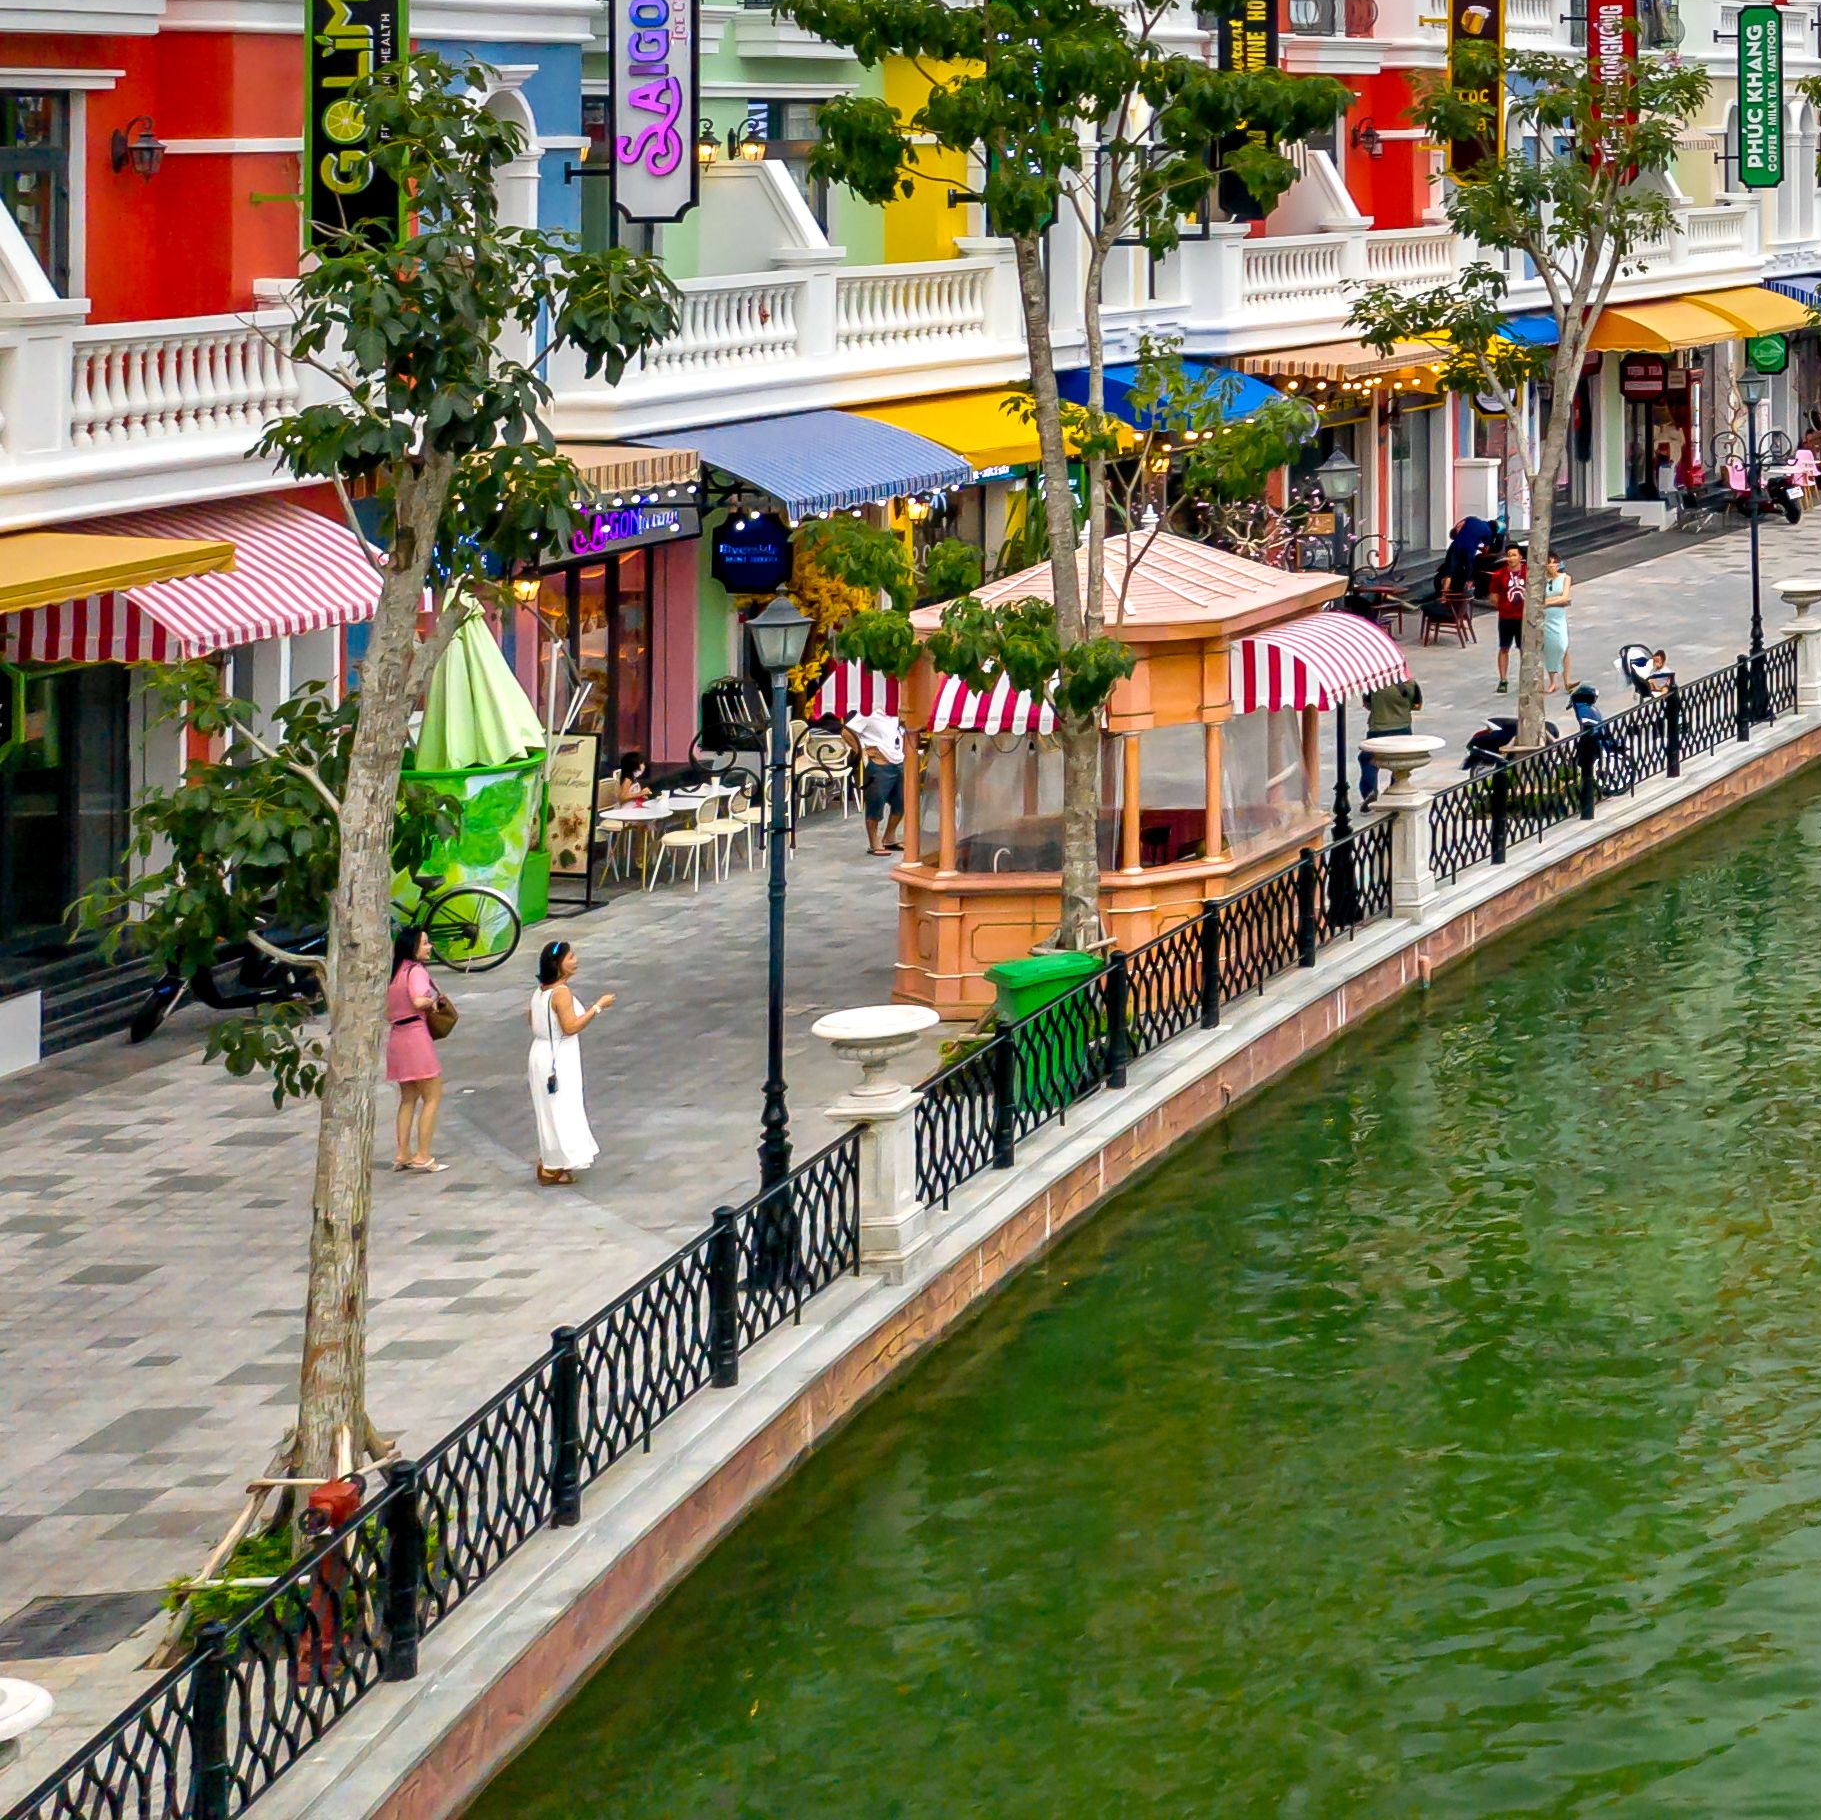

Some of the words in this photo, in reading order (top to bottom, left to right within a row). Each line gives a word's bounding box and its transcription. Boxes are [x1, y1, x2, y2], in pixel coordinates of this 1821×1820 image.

[380, 13, 390, 66] HEALTH
[671, 18, 688, 45] ICE
[1247, 31, 1267, 72] WINE
[1767, 20, 1776, 72] FASTFOOD
[1746, 24, 1763, 103] KHANG
[1742, 108, 1764, 168] PHÚC
[1767, 100, 1776, 128] MILK
